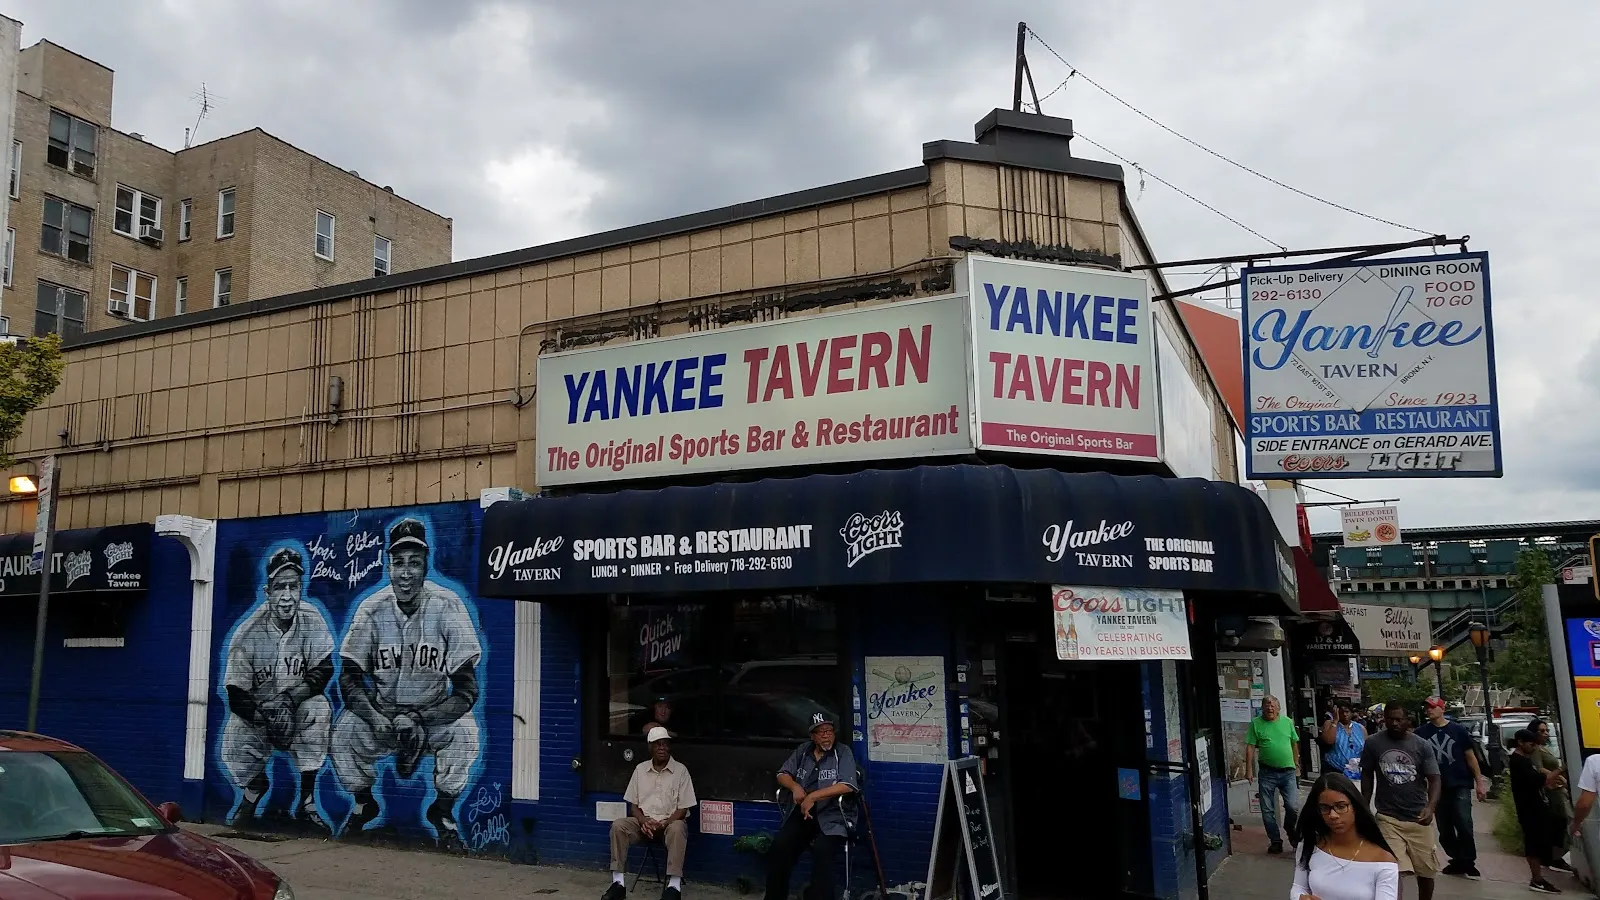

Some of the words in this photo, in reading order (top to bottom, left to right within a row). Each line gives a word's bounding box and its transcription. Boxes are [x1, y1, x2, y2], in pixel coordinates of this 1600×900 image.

[1380, 265, 1431, 278] DINING
[1436, 262, 1483, 275] ROOM
[1250, 275, 1294, 286] Pick-Up
[1299, 273, 1344, 283] Delivery
[1424, 280, 1475, 293] FOOD
[1251, 288, 1322, 301] 292-6130
[1426, 296, 1446, 308] TO
[1449, 294, 1473, 307] GO
[983, 282, 1139, 345] YANKEE
[1251, 308, 1483, 371] Yankee
[563, 353, 727, 424] YANKEE
[743, 324, 932, 404] TAVERN
[1320, 363, 1398, 379] TAVERN
[989, 351, 1141, 410] TAVERN
[1296, 364, 1313, 379] EAST
[1325, 390, 1335, 399] ST
[1256, 396, 1281, 410] The
[1285, 395, 1341, 412] Original
[1385, 392, 1428, 407] Since
[1434, 392, 1478, 406] 1923
[1251, 414, 1321, 434] SPORTS
[1324, 413, 1362, 431] BAR
[1375, 409, 1491, 430] RESTAURANT
[547, 446, 580, 472] The
[585, 434, 664, 472] Original
[668, 428, 741, 465] Sports
[746, 425, 786, 453] Bar
[791, 420, 810, 448] &
[816, 404, 960, 447] Restaurant
[1006, 429, 1027, 443] The
[1030, 429, 1074, 447] Original
[1077, 435, 1113, 449] Sports
[1115, 438, 1134, 450] Bar
[1256, 439, 1288, 452] SIDE
[1291, 437, 1370, 451] ENTRANCE
[1373, 440, 1391, 450] on
[1394, 435, 1458, 448] GERARD
[1460, 434, 1492, 447] AVE.
[1278, 453, 1349, 472] Coors
[1367, 451, 1462, 471] LIGHT
[1344, 510, 1375, 518] BULLPEN
[1367, 515, 1395, 523] DONUT
[839, 510, 904, 545] Coors
[573, 536, 637, 561] SPORTS
[640, 533, 676, 558] BAR
[679, 537, 693, 556] &
[696, 524, 813, 554] RESTAURANT
[847, 530, 903, 568] LIGHT
[1042, 519, 1135, 563] Yankee
[1144, 537, 1165, 552] THE
[1166, 538, 1215, 555] ORIGINAL
[487, 535, 565, 580] Yankee
[591, 565, 618, 578] LUNCH
[630, 563, 662, 577] DINNER
[674, 561, 693, 575] Free
[695, 559, 729, 575] Delivery
[730, 555, 793, 571] 718-292-6130
[1075, 552, 1134, 568] TAVERN
[1148, 556, 1190, 571] SPORTS
[1191, 558, 1214, 573] BAR
[106, 571, 142, 580] Yankee
[513, 567, 562, 581] TAVERN
[107, 580, 140, 588] Tavern
[1053, 589, 1124, 613] Coors
[1125, 597, 1185, 613] LIGHT
[1096, 615, 1125, 625] YANKEE
[1127, 615, 1157, 625] TAVERN
[1385, 607, 1414, 629] Billy's
[639, 612, 674, 646] Quick
[1097, 633, 1163, 642] CELEBRATING
[1380, 628, 1406, 641] Sports
[1408, 629, 1421, 640] Bar
[650, 633, 682, 663] Draw
[1336, 635, 1343, 643] J
[1080, 647, 1091, 656] 90
[1094, 646, 1124, 656] YEARS
[1127, 646, 1137, 656] IN
[1140, 646, 1187, 656] BUSINESS
[869, 682, 939, 720] Yankee
[891, 710, 920, 718] TAVERN
